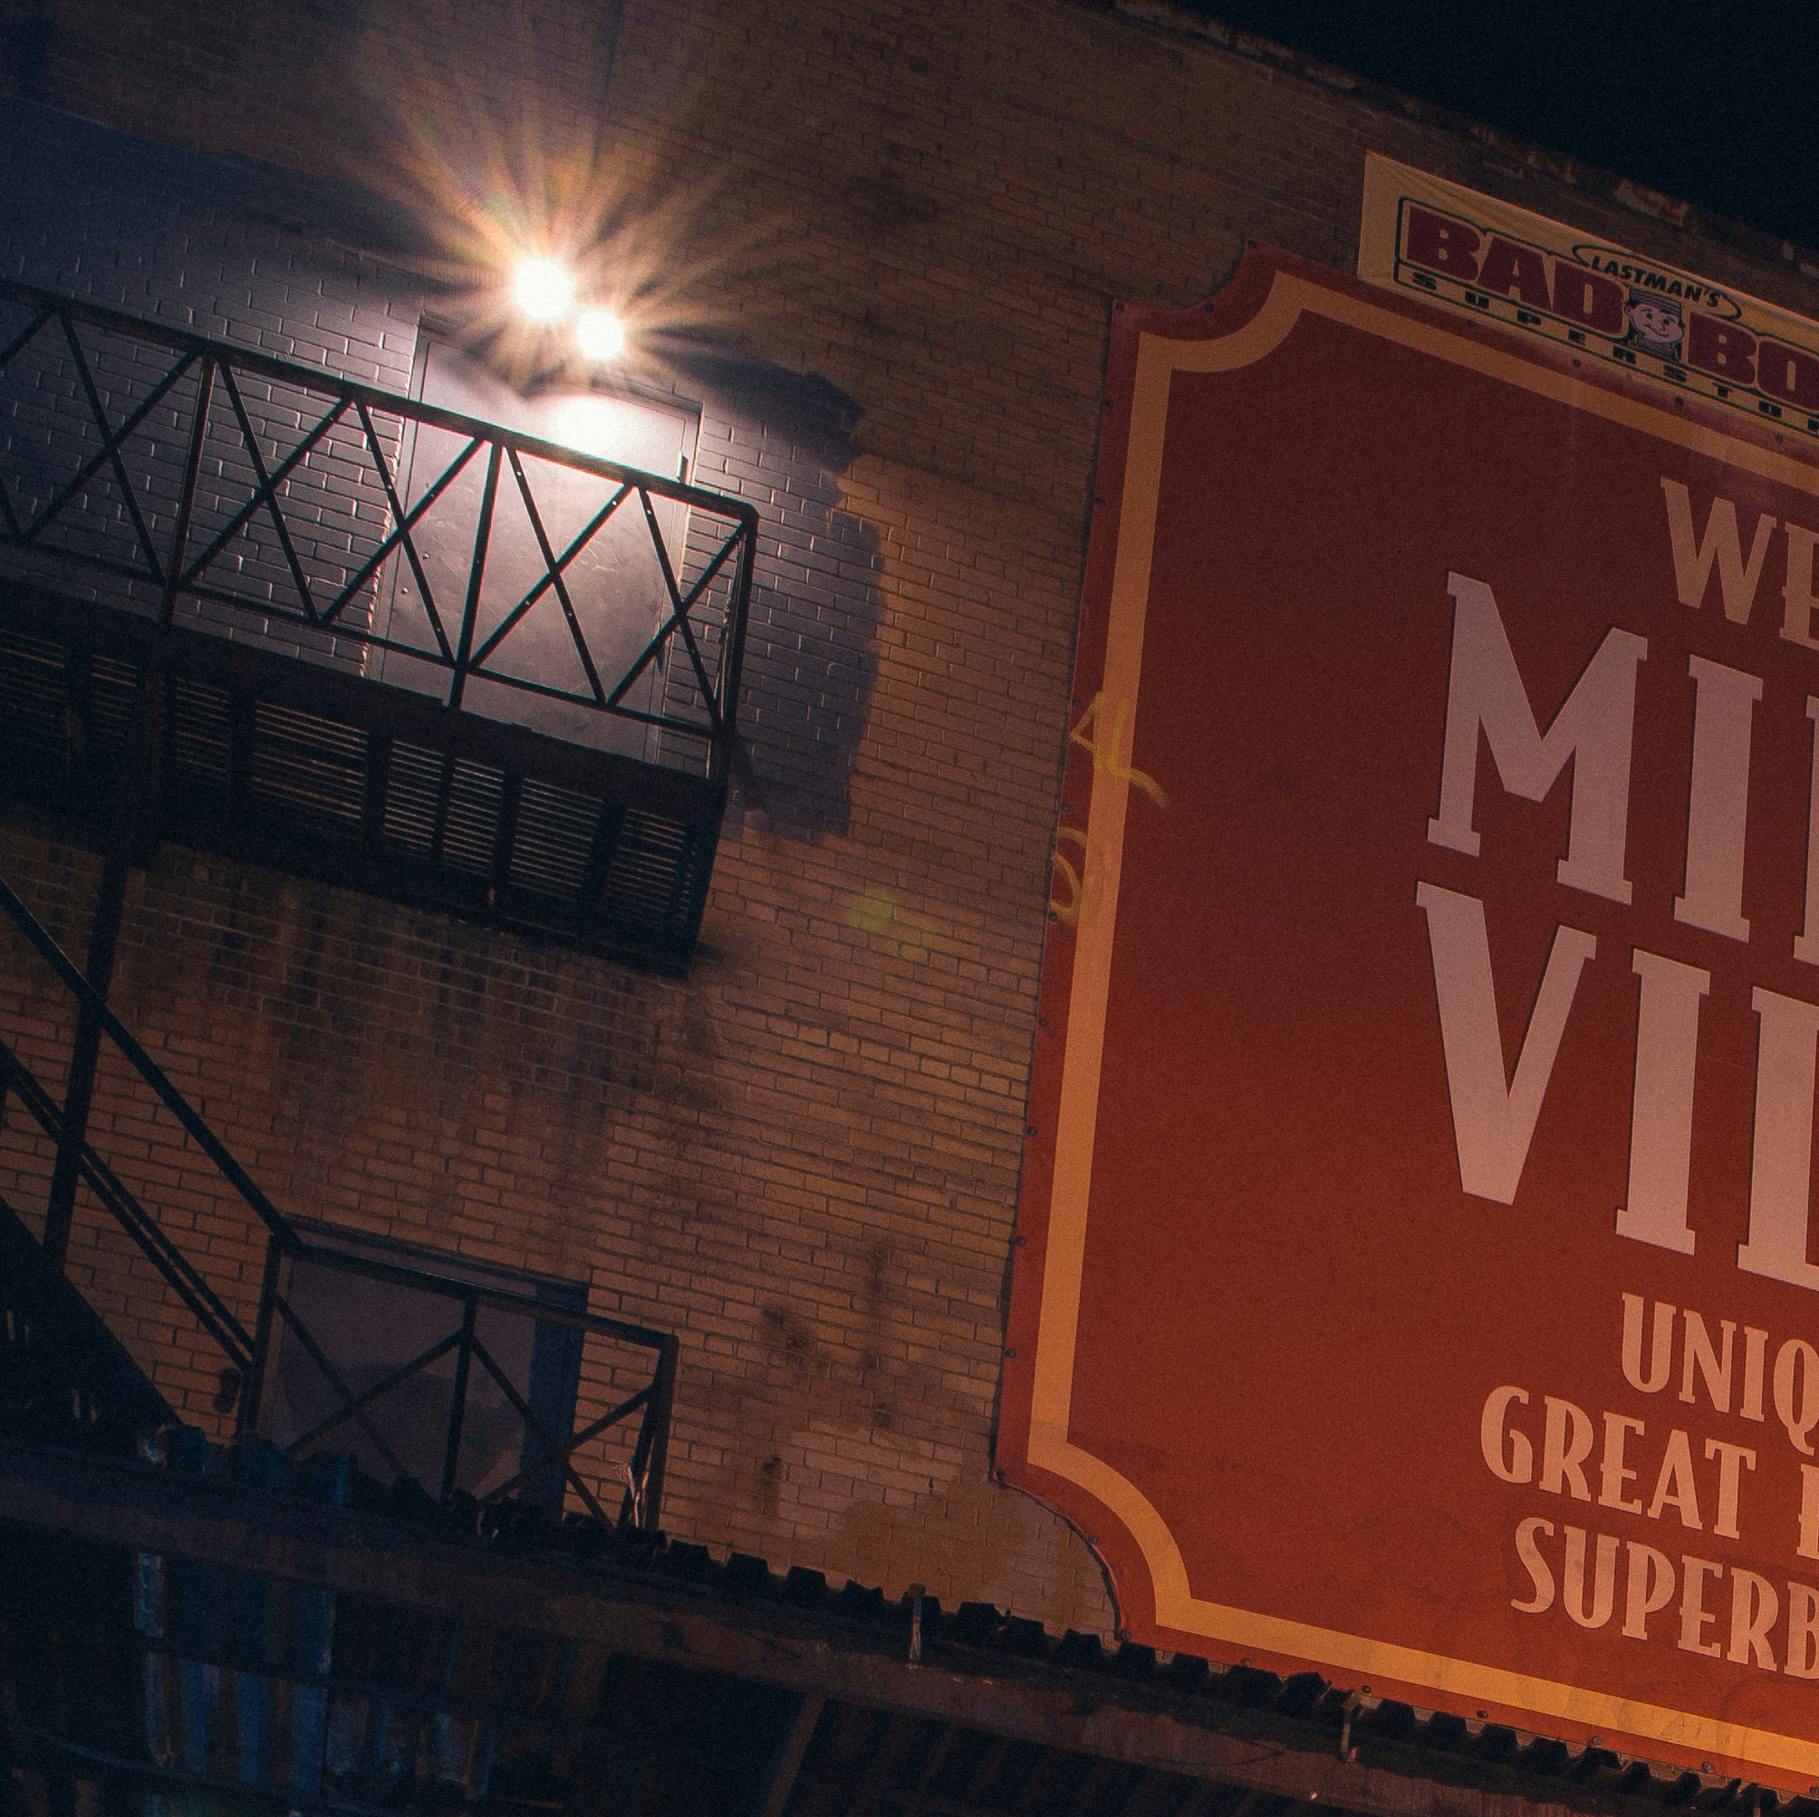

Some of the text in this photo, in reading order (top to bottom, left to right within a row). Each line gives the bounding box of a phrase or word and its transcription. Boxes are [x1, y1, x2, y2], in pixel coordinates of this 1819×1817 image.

[1405, 205, 1625, 337] BAD
[1590, 255, 1723, 307] LASTMAN'S
[1480, 1385, 1757, 1540] GREAT
